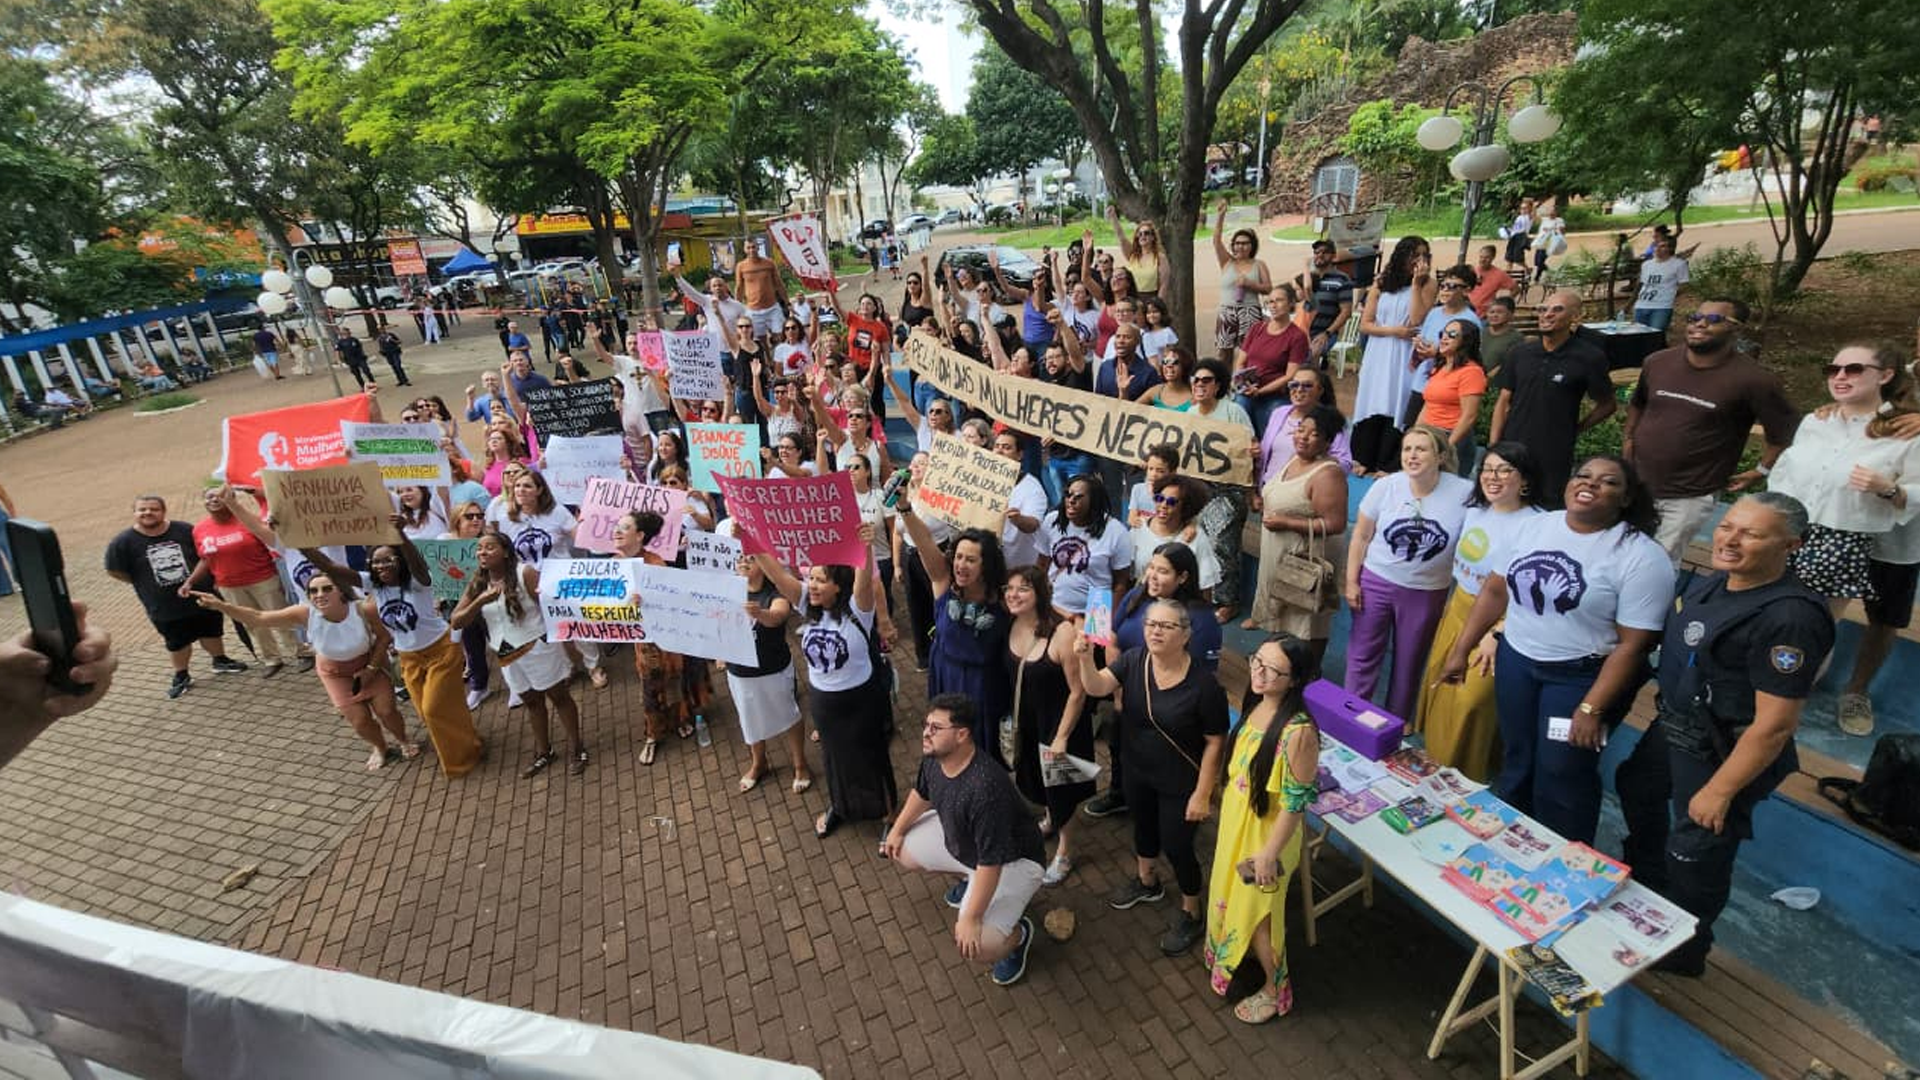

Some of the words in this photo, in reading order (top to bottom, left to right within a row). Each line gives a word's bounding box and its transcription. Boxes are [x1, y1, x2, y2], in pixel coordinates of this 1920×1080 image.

[979, 373, 1090, 441] MULHERES
[1096, 411, 1232, 476] NEGRAS
[724, 460, 756, 478] 180
[280, 474, 368, 499] NENHUMA
[590, 480, 671, 516] MULHERES
[722, 480, 842, 505] SECRETARIA
[293, 494, 369, 520] MULHER
[918, 485, 965, 517] MORTE
[987, 498, 1004, 513] DE
[735, 502, 756, 522] DA
[763, 505, 844, 526] MULHER
[768, 527, 842, 547] LIMEIRA
[568, 561, 620, 576] EDUCAR
[773, 545, 813, 568] JÁ
[553, 575, 629, 602] HOMENS
[547, 605, 575, 618] PARA
[579, 605, 643, 621] RESPEITAR
[566, 620, 647, 641] MULHERES
